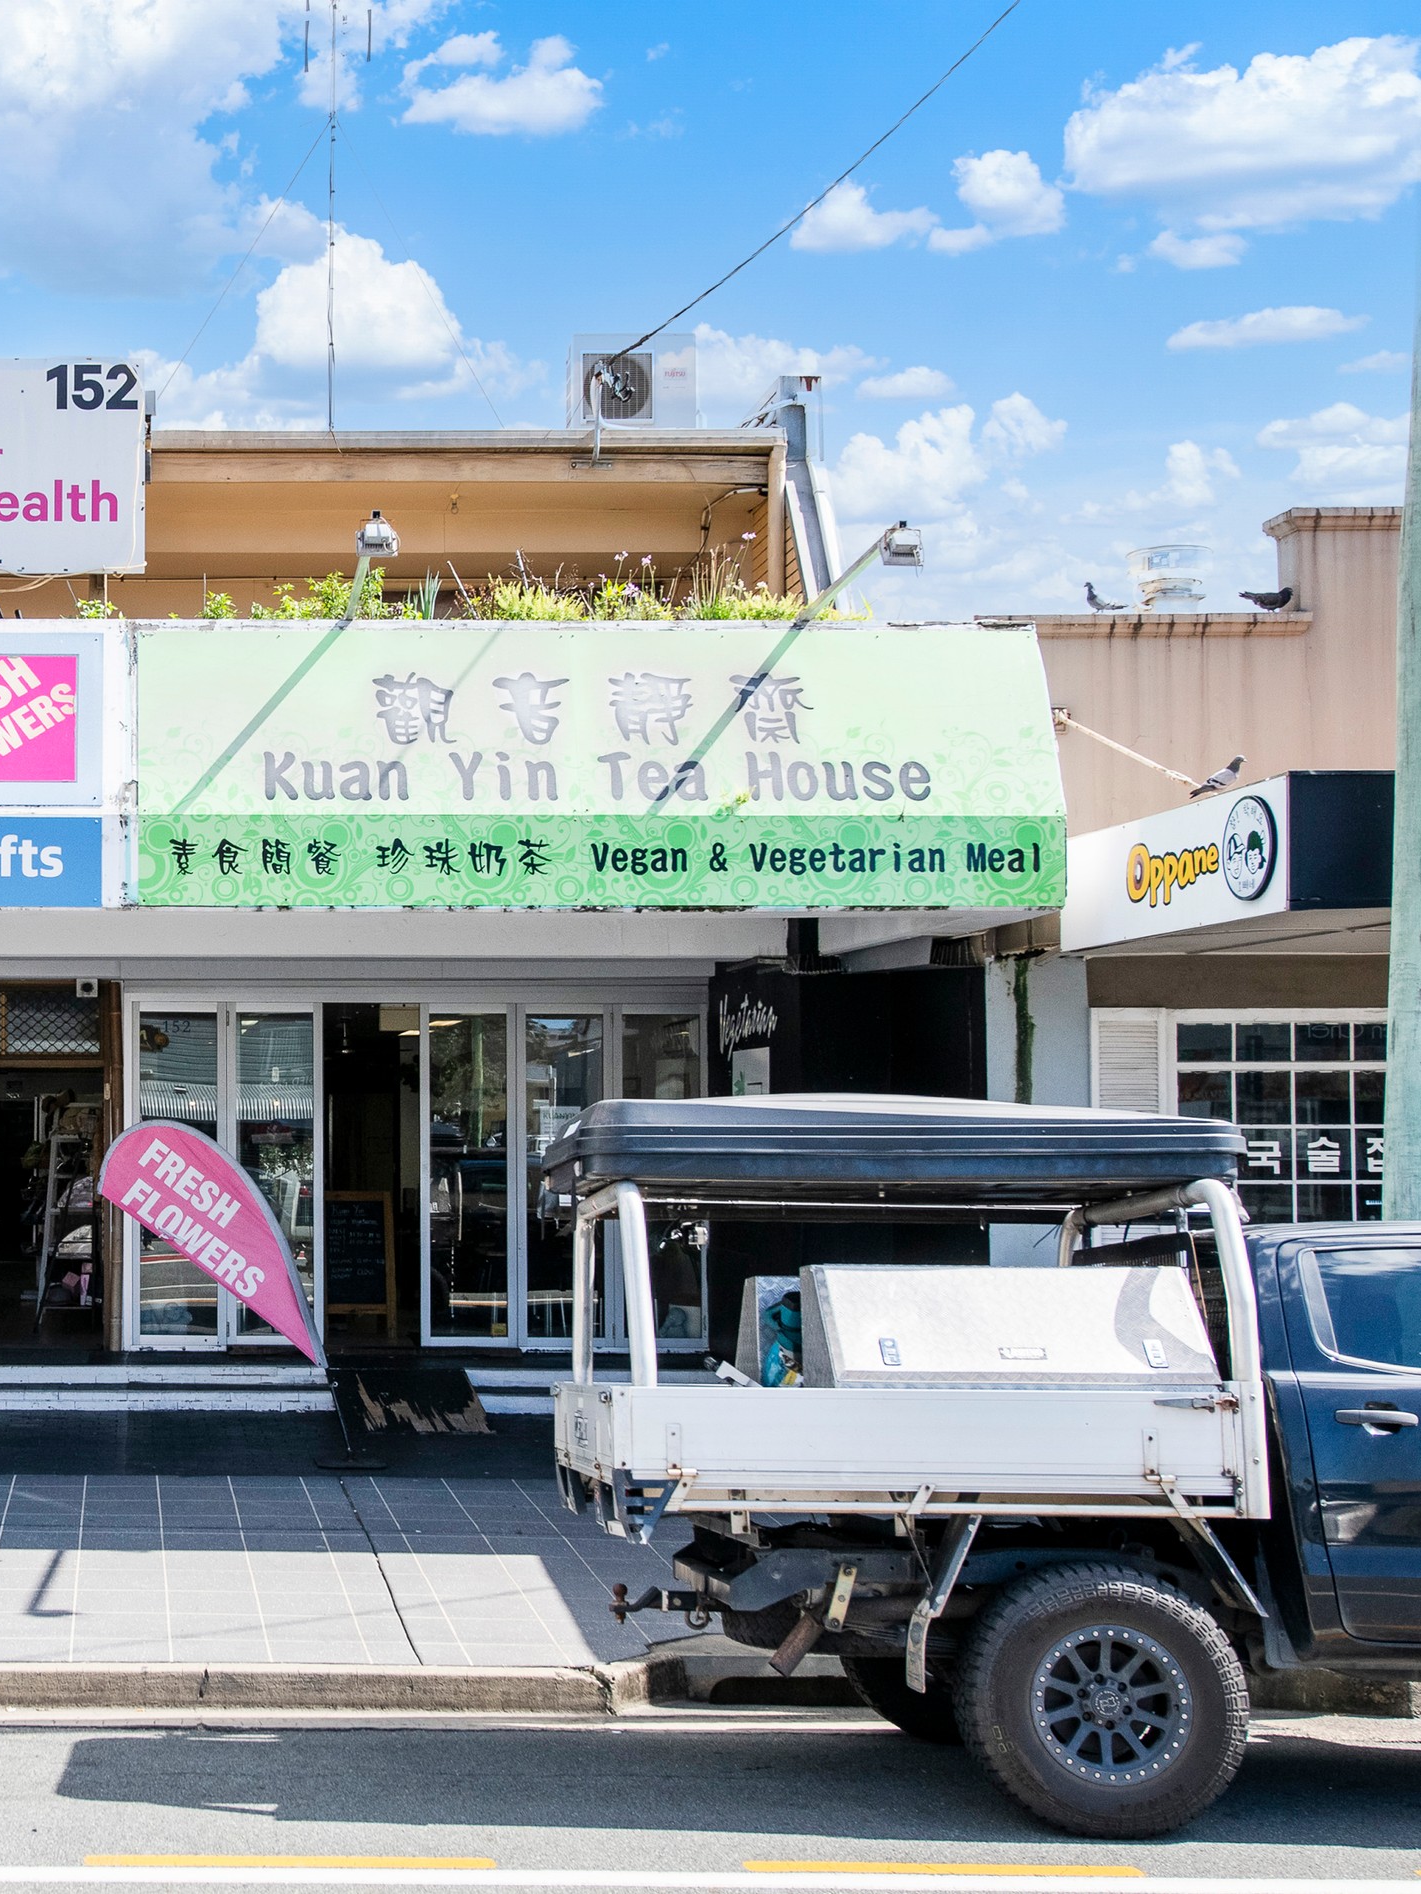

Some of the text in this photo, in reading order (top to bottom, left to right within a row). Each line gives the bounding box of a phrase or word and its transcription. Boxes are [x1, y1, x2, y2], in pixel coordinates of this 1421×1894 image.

[46, 364, 139, 411] 152
[263, 751, 932, 802] Kuan Yin Tea House
[375, 837, 555, 877] 珍珠奶茶
[590, 842, 1041, 875] Vegan & Vegetarian Meal
[1126, 842, 1220, 909] Oppane
[162, 1020, 192, 1033] 152
[137, 1137, 242, 1229] FRESH
[120, 1178, 266, 1298] FLOWERS
